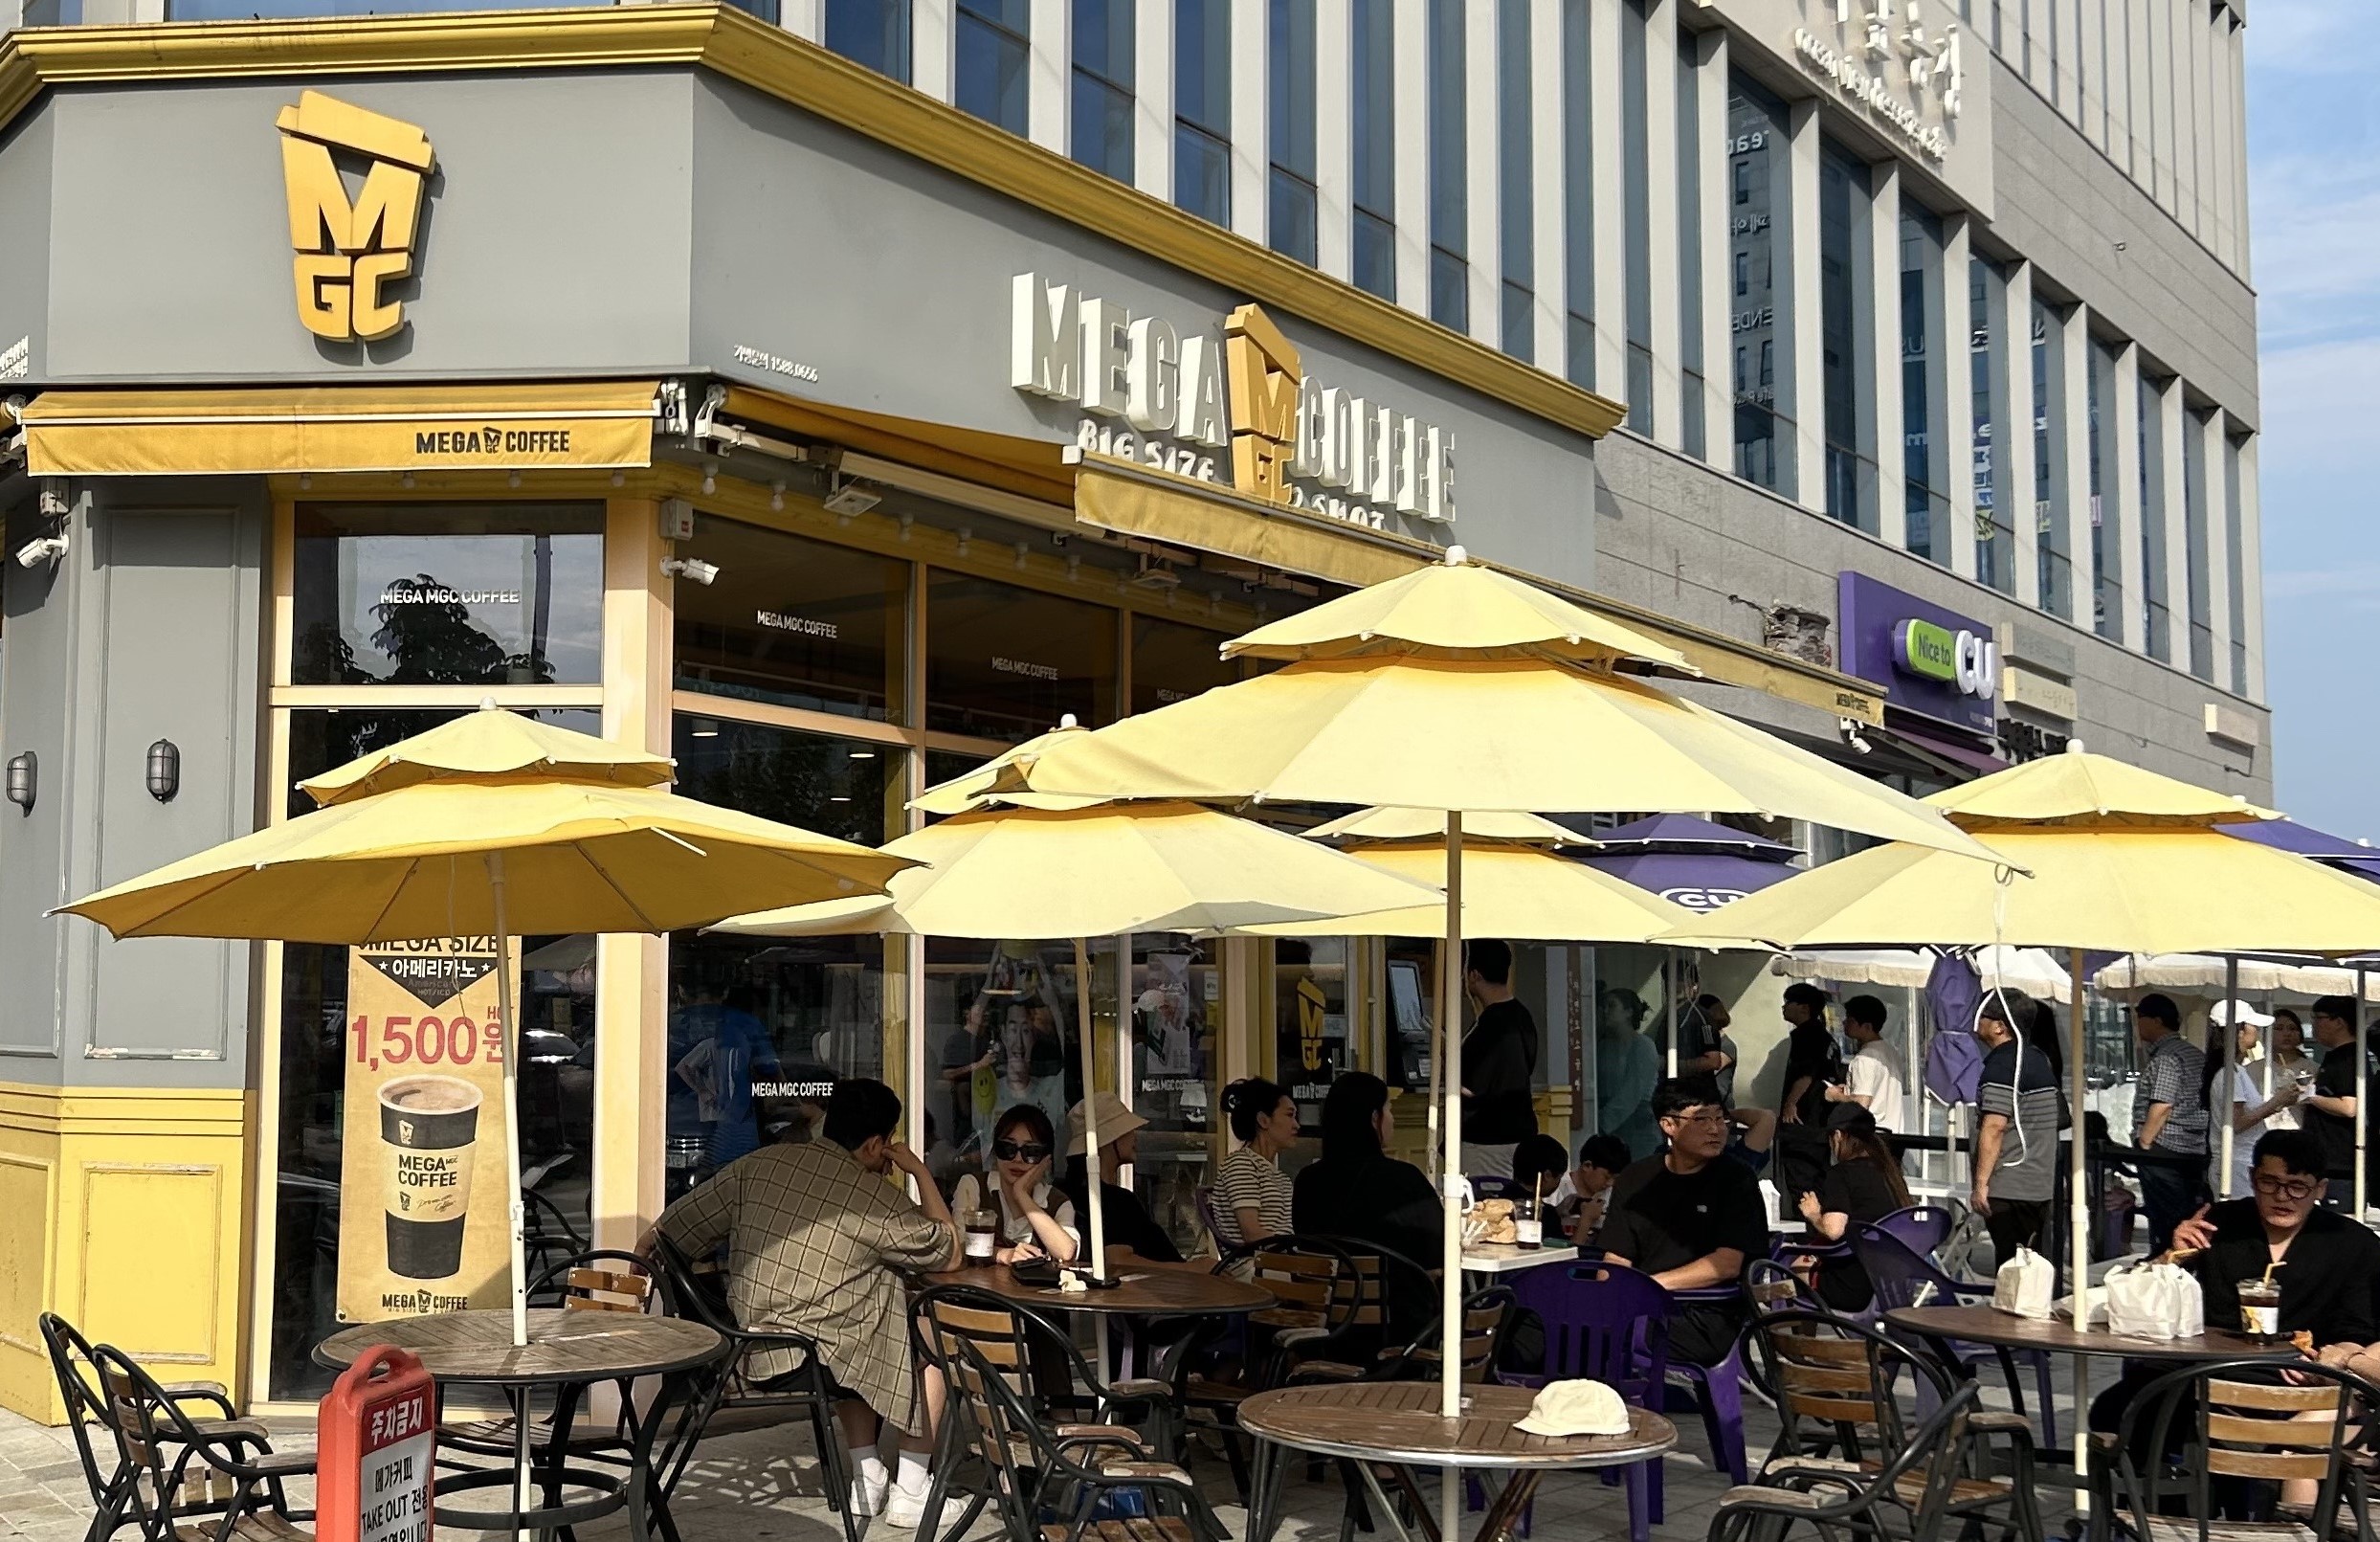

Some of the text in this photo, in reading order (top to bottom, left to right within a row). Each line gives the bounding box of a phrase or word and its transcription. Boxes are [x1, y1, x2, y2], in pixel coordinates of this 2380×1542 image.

[1012, 272, 1228, 448] MEGA
[1295, 374, 1456, 524] COFFEE
[416, 432, 481, 454] MEGA
[505, 431, 570, 453] COFFEE
[1077, 418, 1134, 461] BIG
[1145, 441, 1213, 482] SIZE
[381, 589, 520, 603] MEGA MGC COFFEE
[757, 610, 837, 638] MEGA MGC COFFEE
[1918, 633, 1939, 663] Nice
[1941, 642, 1951, 667] to
[1955, 630, 1995, 701] CU
[392, 959, 478, 978] 아메리카노
[751, 1082, 778, 1097] MEGA
[778, 1082, 799, 1097] MGC
[399, 1154, 446, 1171] MEGA
[398, 1170, 457, 1187] COFFEE
[382, 1293, 415, 1307] MEGA
[434, 1296, 468, 1310] COFFEE
[371, 1397, 423, 1446] 주차금지
[375, 1456, 413, 1493] 메가커피
[362, 1504, 384, 1536] TAKE
[386, 1494, 408, 1523] OUT
[411, 1485, 428, 1514] 전용
